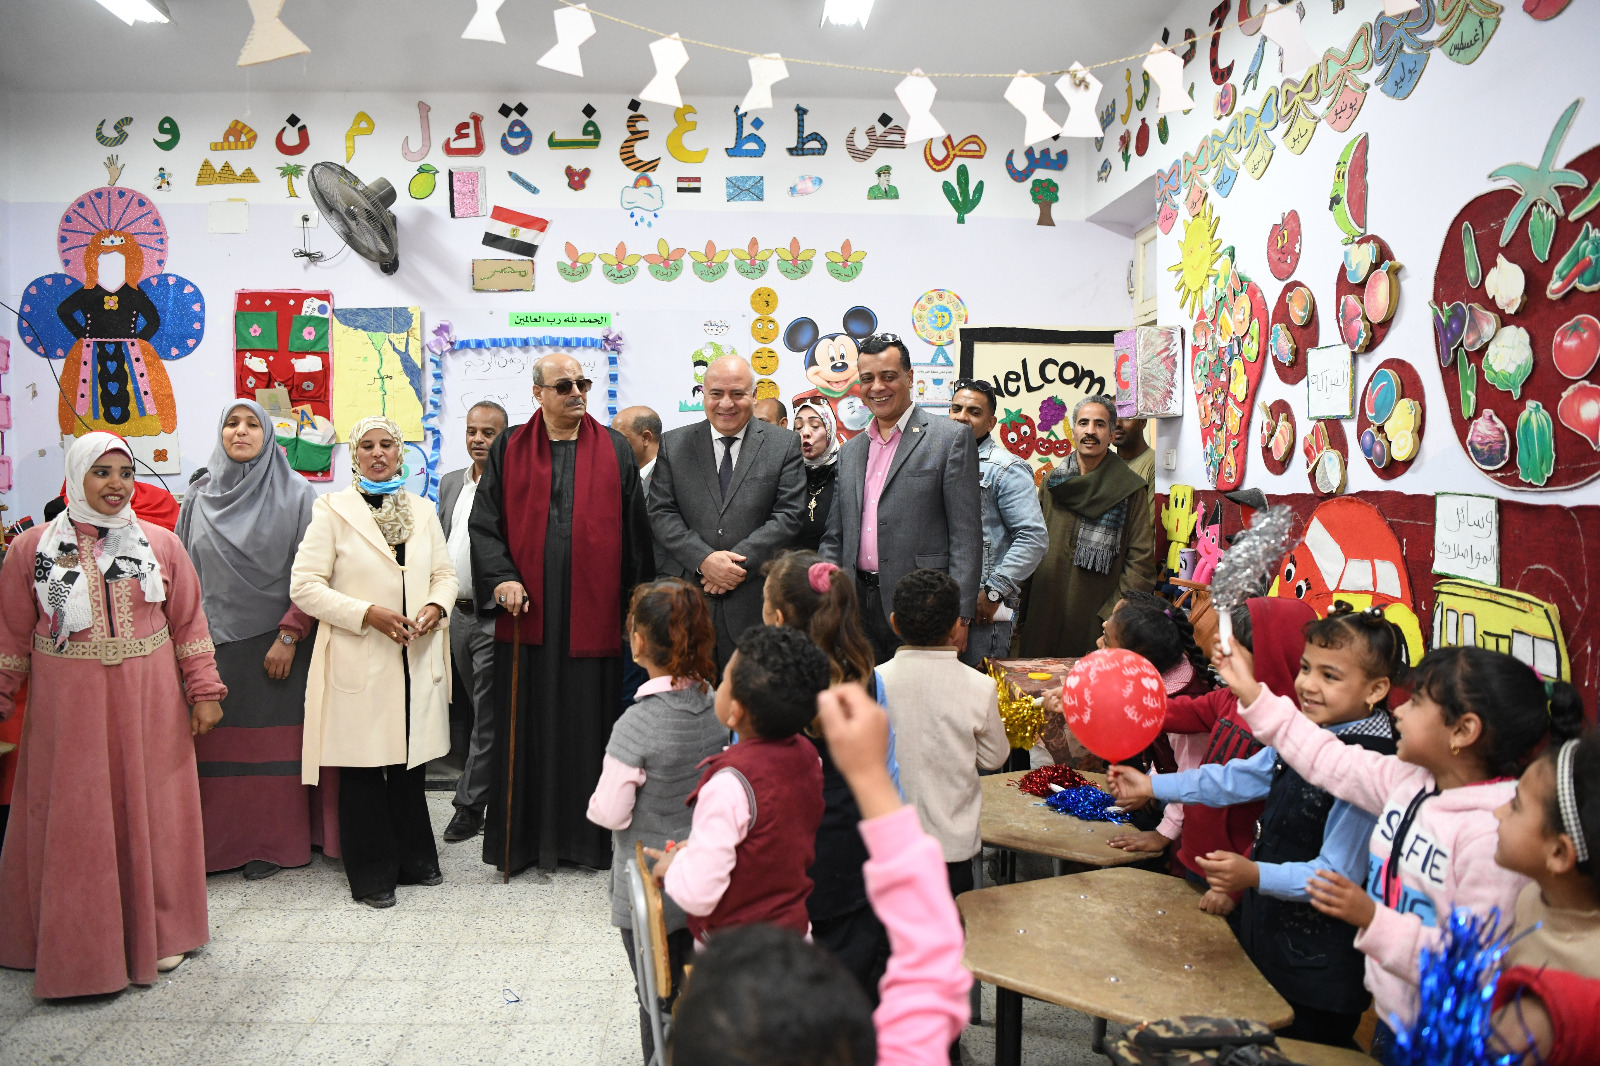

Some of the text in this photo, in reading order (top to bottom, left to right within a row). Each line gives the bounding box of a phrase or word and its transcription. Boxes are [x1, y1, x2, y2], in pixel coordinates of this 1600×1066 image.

[153, 116, 180, 151] و
[275, 113, 310, 156] ن
[345, 111, 375, 163] م
[402, 101, 431, 162] ل
[442, 112, 485, 157] ك
[498, 102, 533, 155] ق
[548, 103, 601, 150] ف
[619, 98, 661, 173] غ
[666, 104, 709, 163] ع
[725, 105, 767, 158] ظ
[786, 104, 828, 156] ط
[846, 112, 908, 162] ض
[924, 134, 987, 172] ص
[480, 266, 529, 280] مصر
[514, 315, 545, 326] العالمين
[546, 316, 562, 326] رب
[579, 316, 607, 325] الحمد
[1443, 500, 1493, 539] وسائل
[1436, 541, 1496, 570] المواصلات
